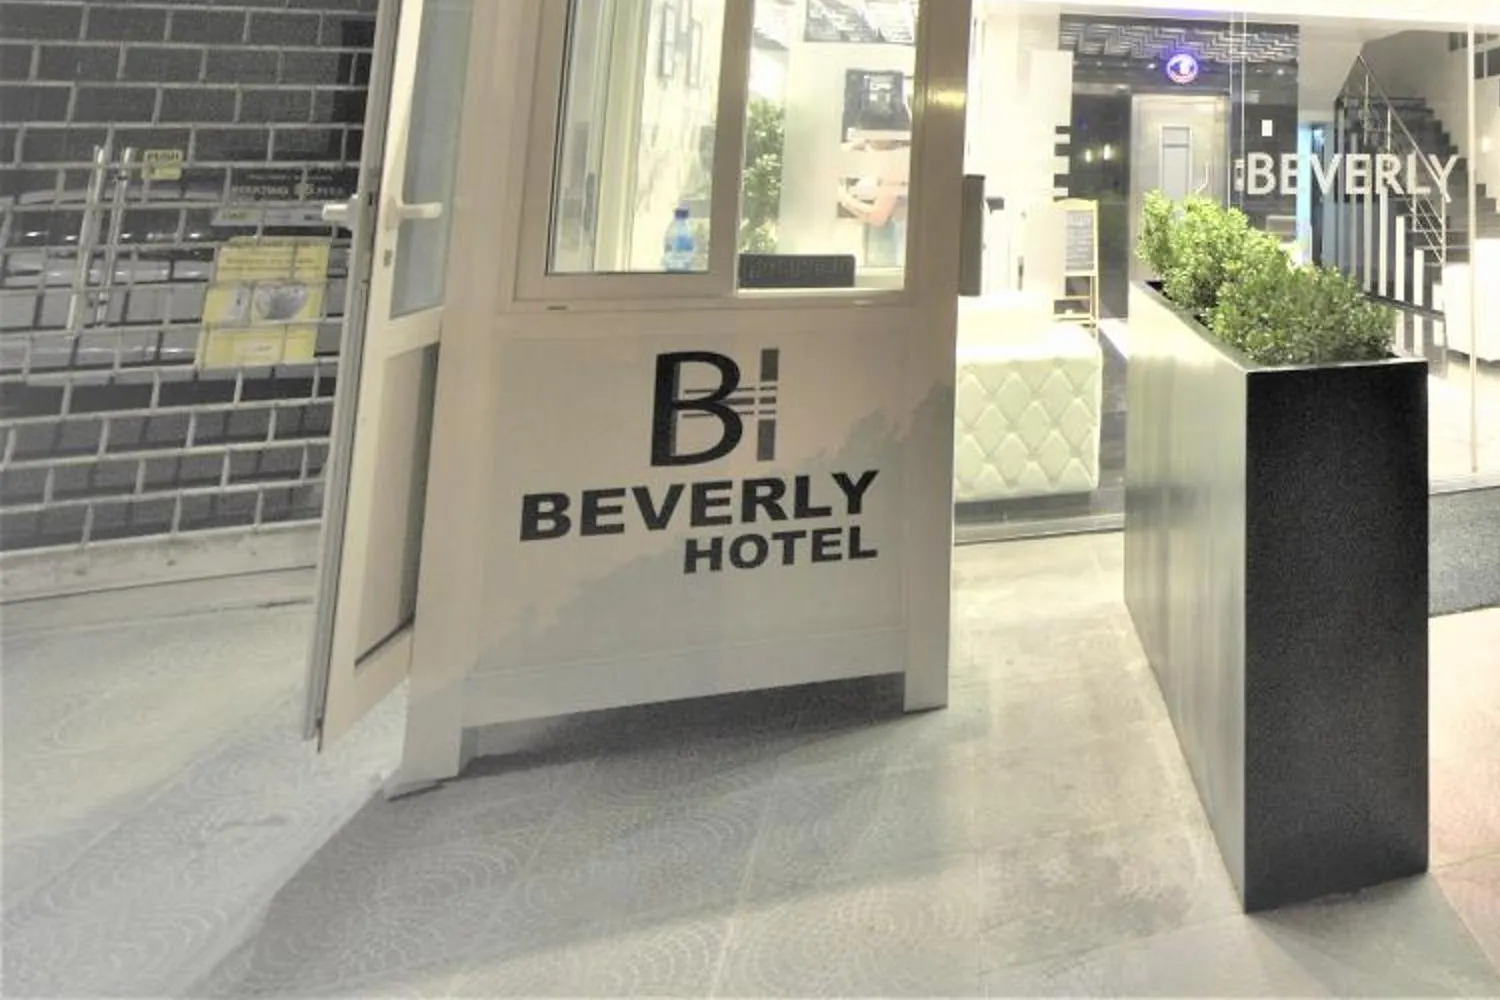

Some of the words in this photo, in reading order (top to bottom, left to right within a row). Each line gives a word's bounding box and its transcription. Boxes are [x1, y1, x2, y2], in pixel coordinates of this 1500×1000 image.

[1247, 153, 1459, 194] BEVERLY
[519, 470, 880, 542] BEVERLY
[683, 526, 879, 574] HOTEL
